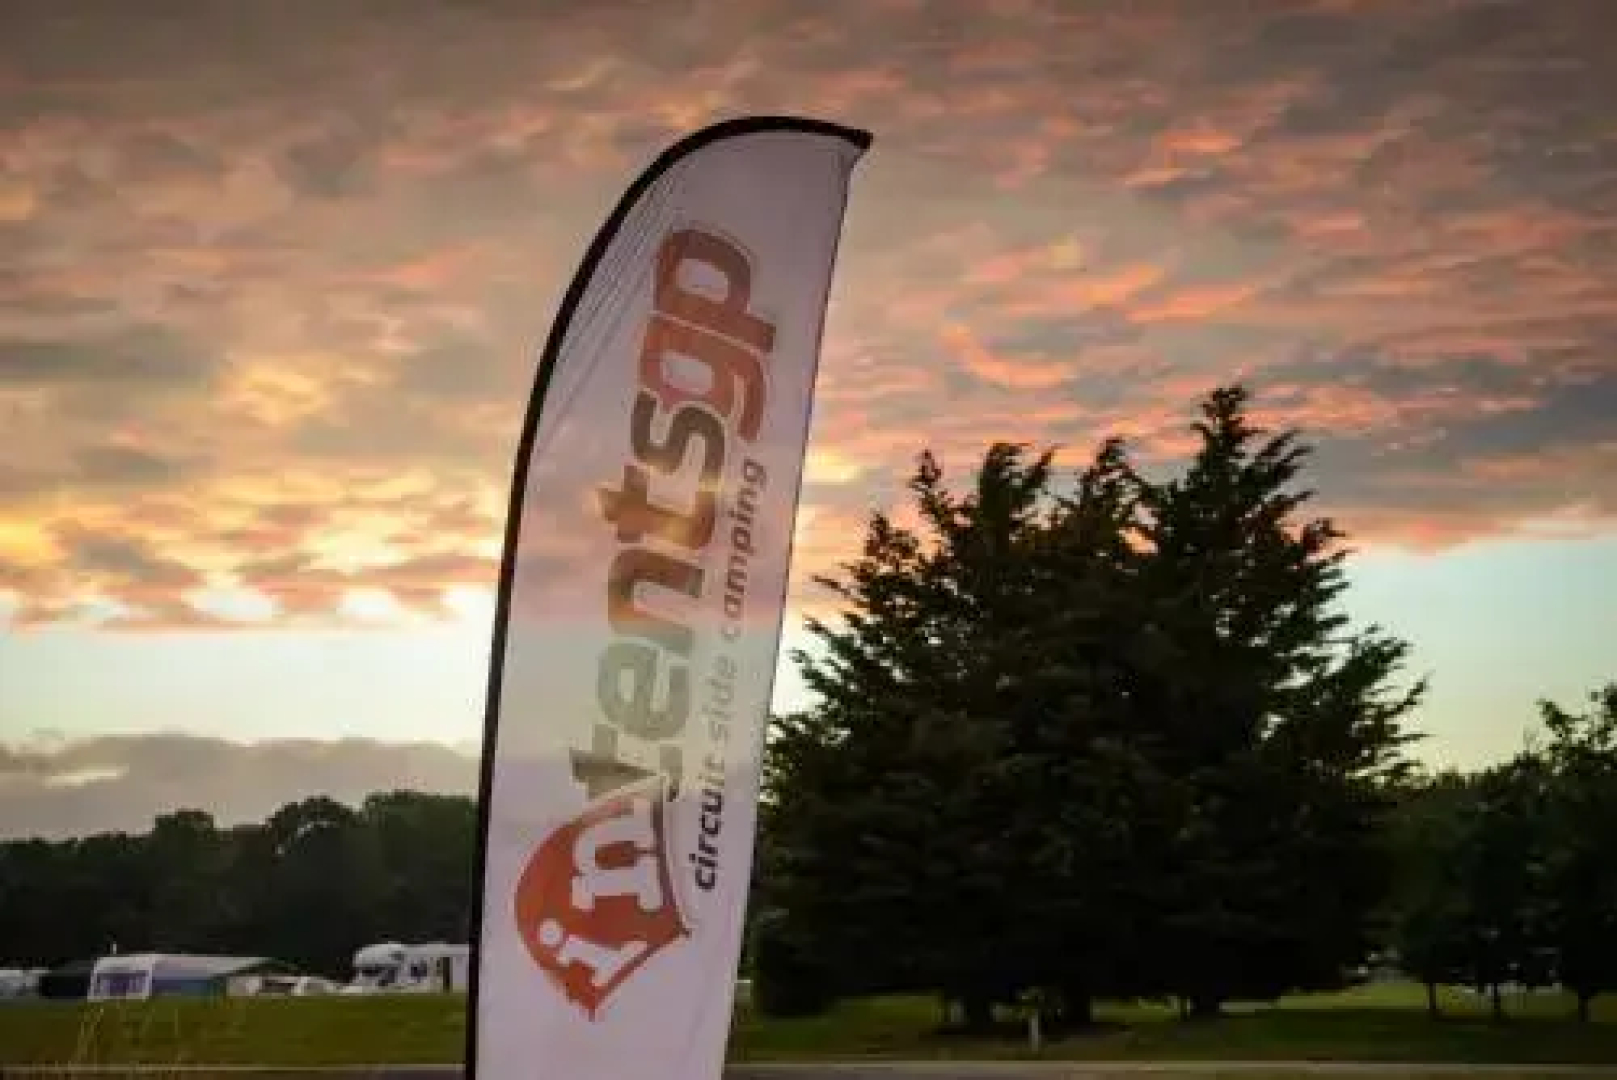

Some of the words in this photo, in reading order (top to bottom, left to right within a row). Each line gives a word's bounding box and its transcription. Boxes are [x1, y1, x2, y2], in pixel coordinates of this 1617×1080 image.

[536, 228, 777, 988] intentsgp
[720, 458, 768, 643] camping
[702, 655, 737, 741] side
[689, 753, 726, 890] circuit
